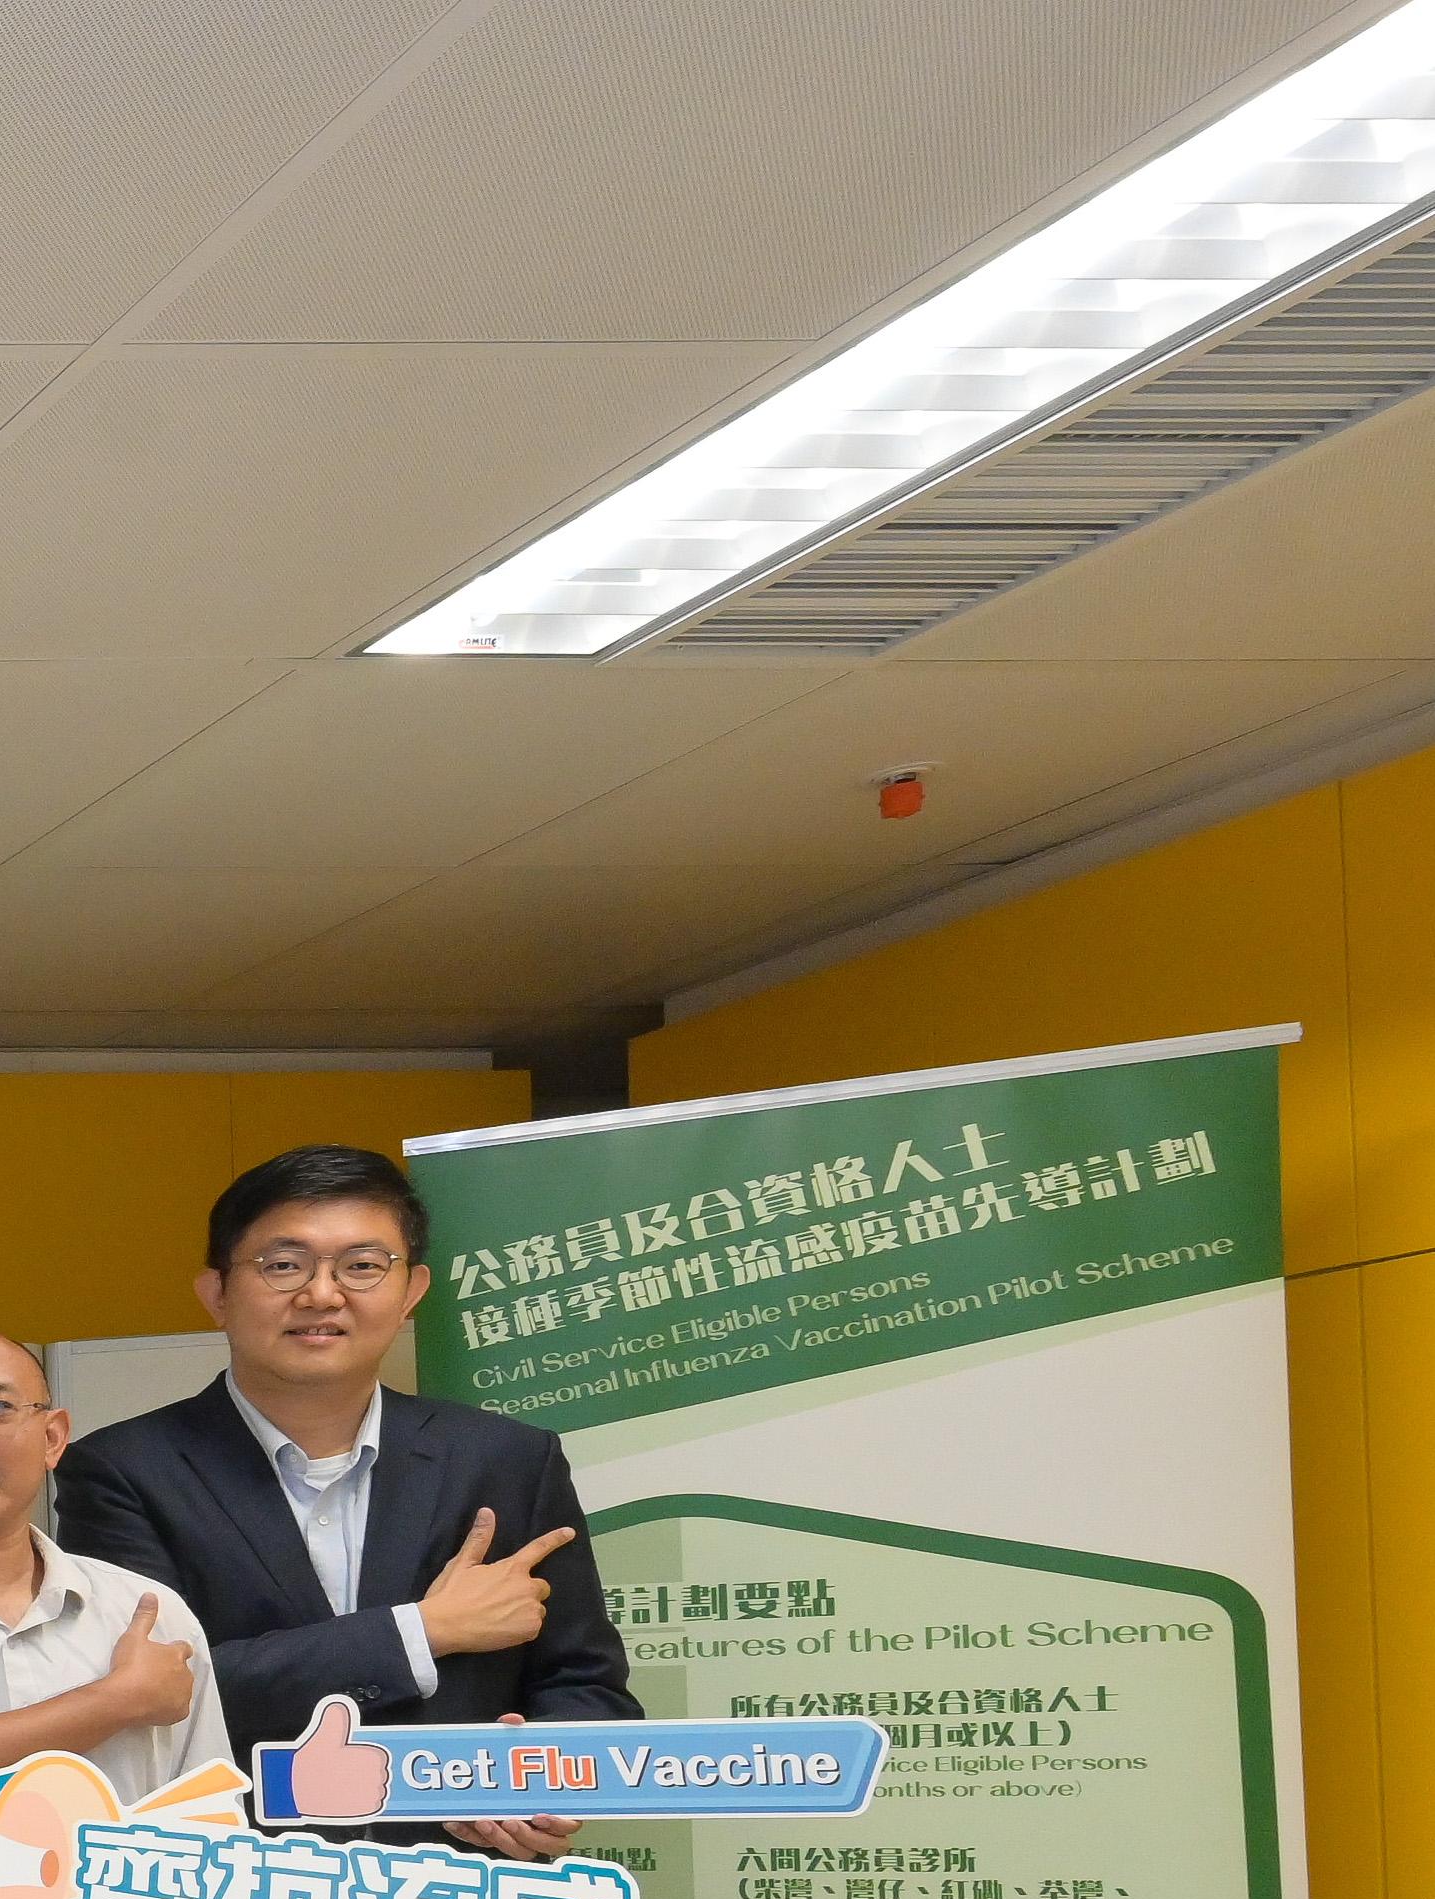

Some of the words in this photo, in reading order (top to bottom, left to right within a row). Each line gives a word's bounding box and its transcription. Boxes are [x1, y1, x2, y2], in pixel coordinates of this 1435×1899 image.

[449, 1123, 1010, 1300] 公務員及合資格人士
[460, 1130, 1218, 1350] 接種季節性流感疫苗先導計劃
[471, 1355, 537, 1390] Civil
[540, 1330, 666, 1376] Service
[670, 1302, 782, 1347] Eligible
[788, 1268, 932, 1317] Persons
[479, 1370, 620, 1416] Seasonal
[624, 1338, 771, 1387] Influenza
[774, 1293, 983, 1353] Vaccination
[987, 1269, 1069, 1305] Pilot
[1074, 1237, 1235, 1285] Scheme
[796, 1628, 836, 1655] of
[848, 1627, 914, 1654] the
[924, 1621, 1016, 1652] Pilot
[1026, 1617, 1215, 1648] Scheme
[730, 1685, 1119, 1718] 所有公務員及合資格人士
[401, 1744, 499, 1791] Get
[508, 1744, 599, 1791] Flu
[606, 1742, 841, 1790] Vaccine
[934, 1754, 1025, 1776] Eligible
[1030, 1753, 1148, 1772] Persons
[874, 1781, 946, 1798] onths
[952, 1783, 983, 1799] or
[990, 1779, 1084, 1800] above)
[736, 1846, 977, 1874] 六間公務員診所
